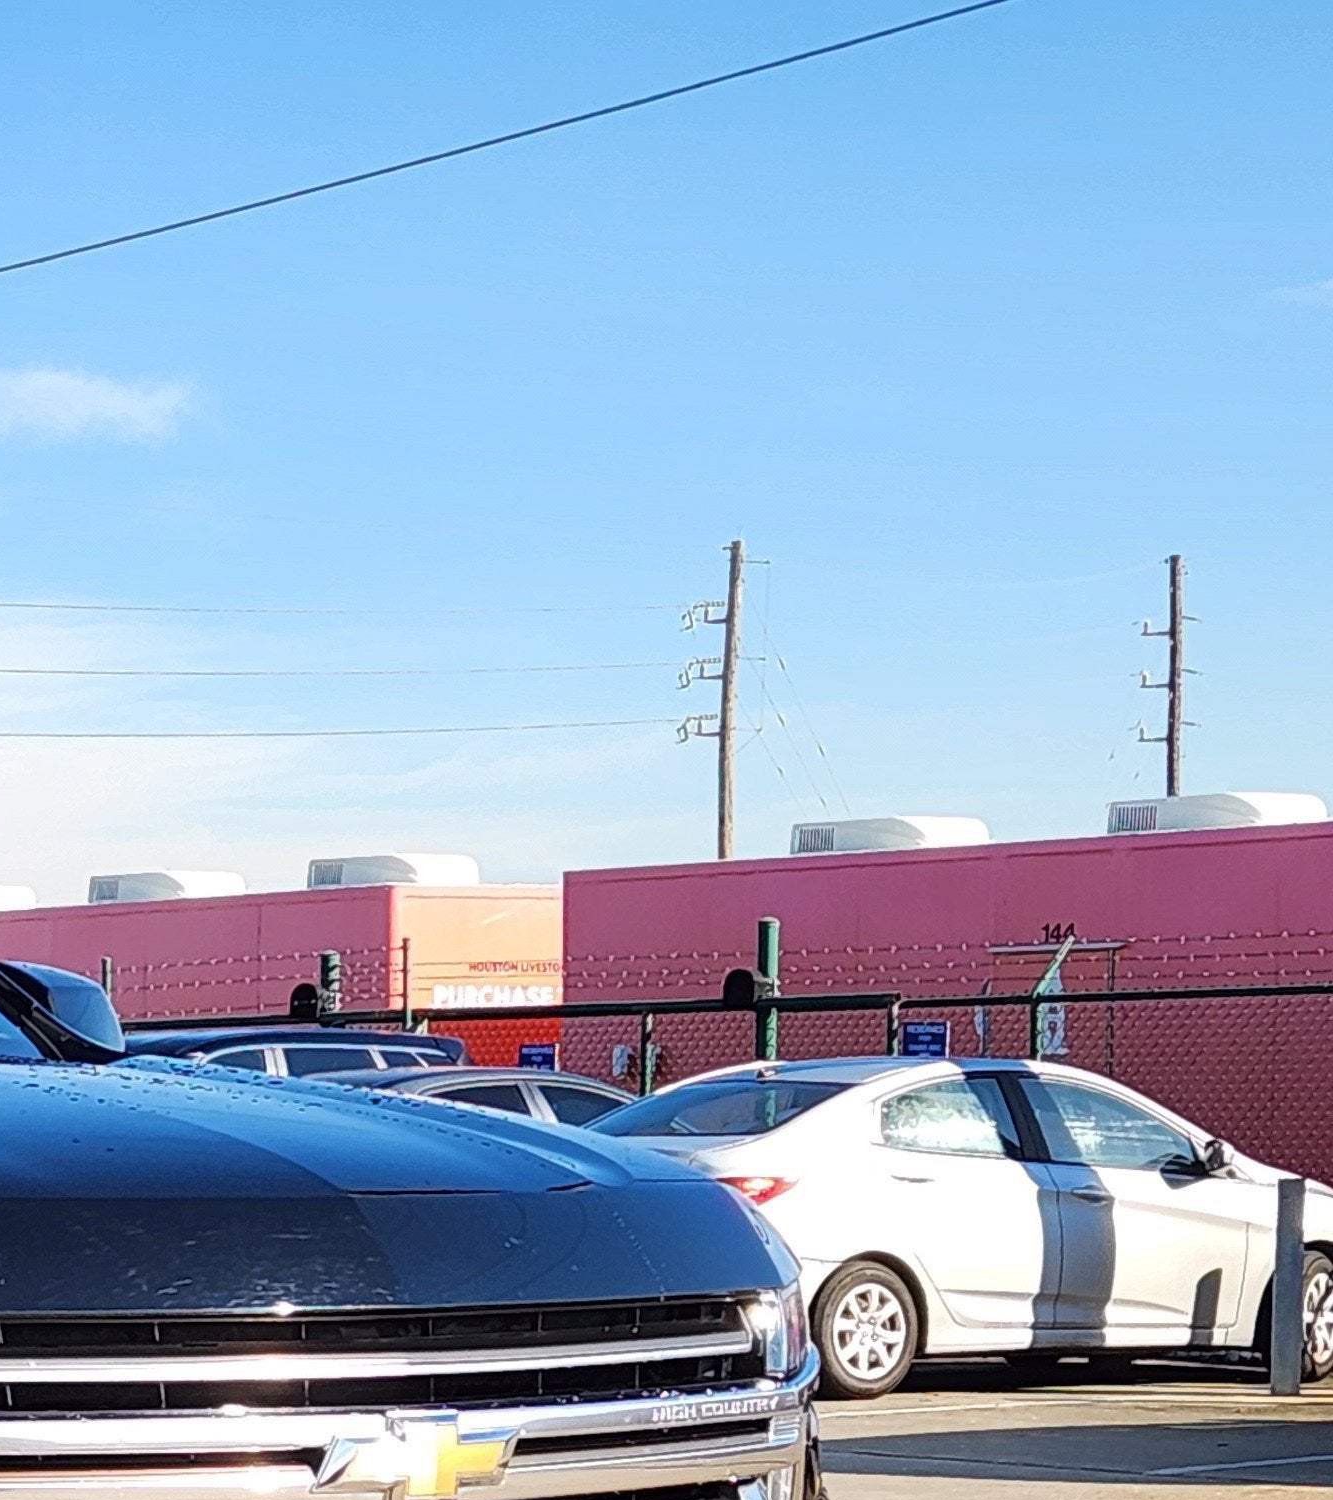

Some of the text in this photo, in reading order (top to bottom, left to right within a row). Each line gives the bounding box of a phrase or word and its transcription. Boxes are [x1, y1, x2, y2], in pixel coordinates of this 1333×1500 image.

[468, 961, 518, 973] HOUSTON
[433, 983, 554, 1008] PURCHASE
[652, 1396, 779, 1422] HIGH COUNTRY
